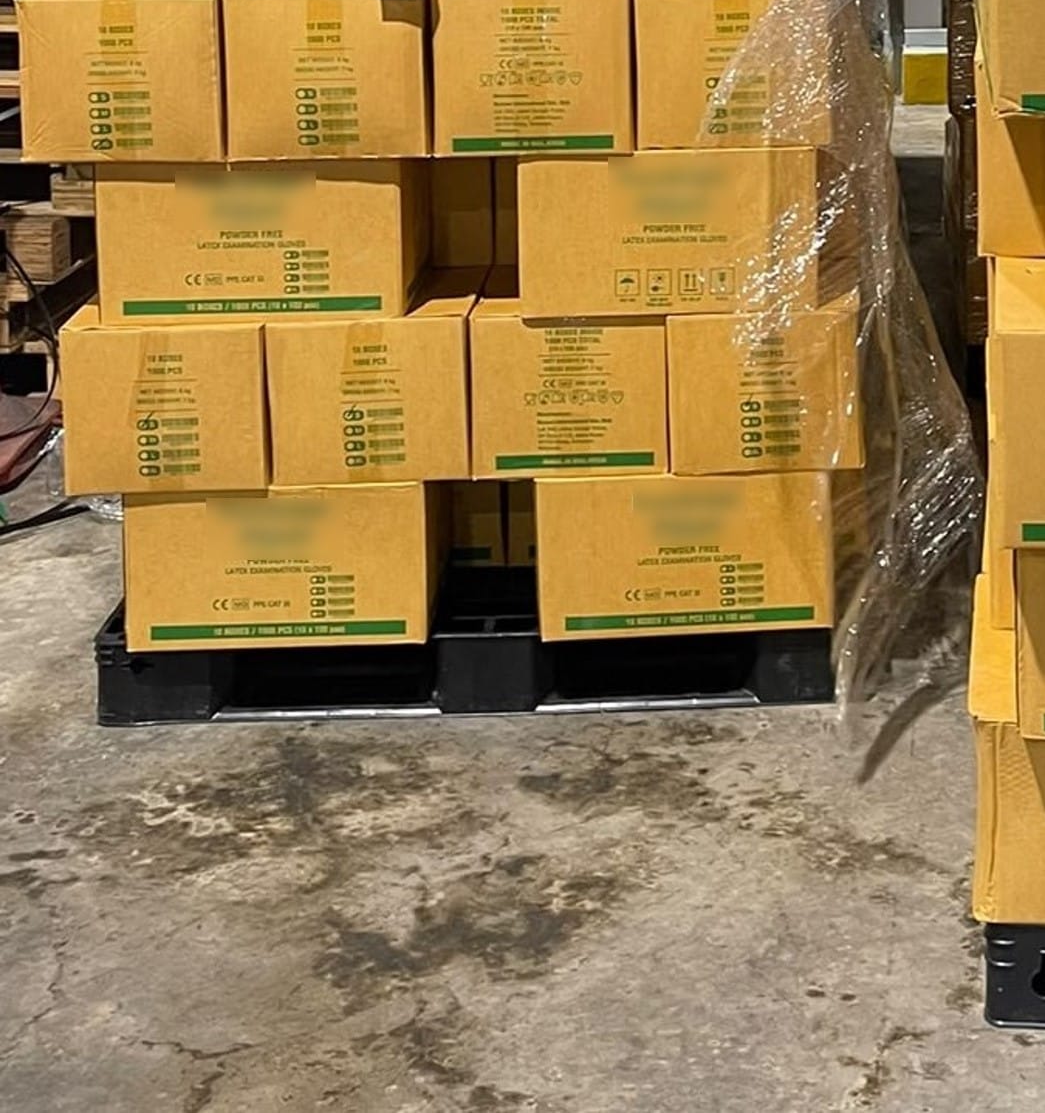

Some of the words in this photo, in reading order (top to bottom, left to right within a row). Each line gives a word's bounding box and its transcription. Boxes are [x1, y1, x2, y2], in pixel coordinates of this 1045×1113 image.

[643, 224, 682, 233] POWDER
[684, 224, 706, 233] FREE
[220, 230, 259, 239] POWDER
[261, 230, 283, 239] FREE
[622, 236, 645, 244] LATEX
[646, 236, 698, 244] EXAMINATION
[699, 235, 728, 243] GLOVES
[197, 241, 221, 250] LATEX
[222, 241, 275, 249] EXAMINATION
[277, 240, 306, 248] GLOVES
[658, 546, 696, 556] POWDER
[698, 545, 720, 554] FREE
[637, 558, 660, 566] LATEX
[661, 556, 713, 565] EXAMINATION
[713, 554, 742, 563] GLOVES
[225, 567, 248, 575] LATEX
[249, 566, 302, 575] EXAMINATION
[303, 565, 332, 573] GLOVES
